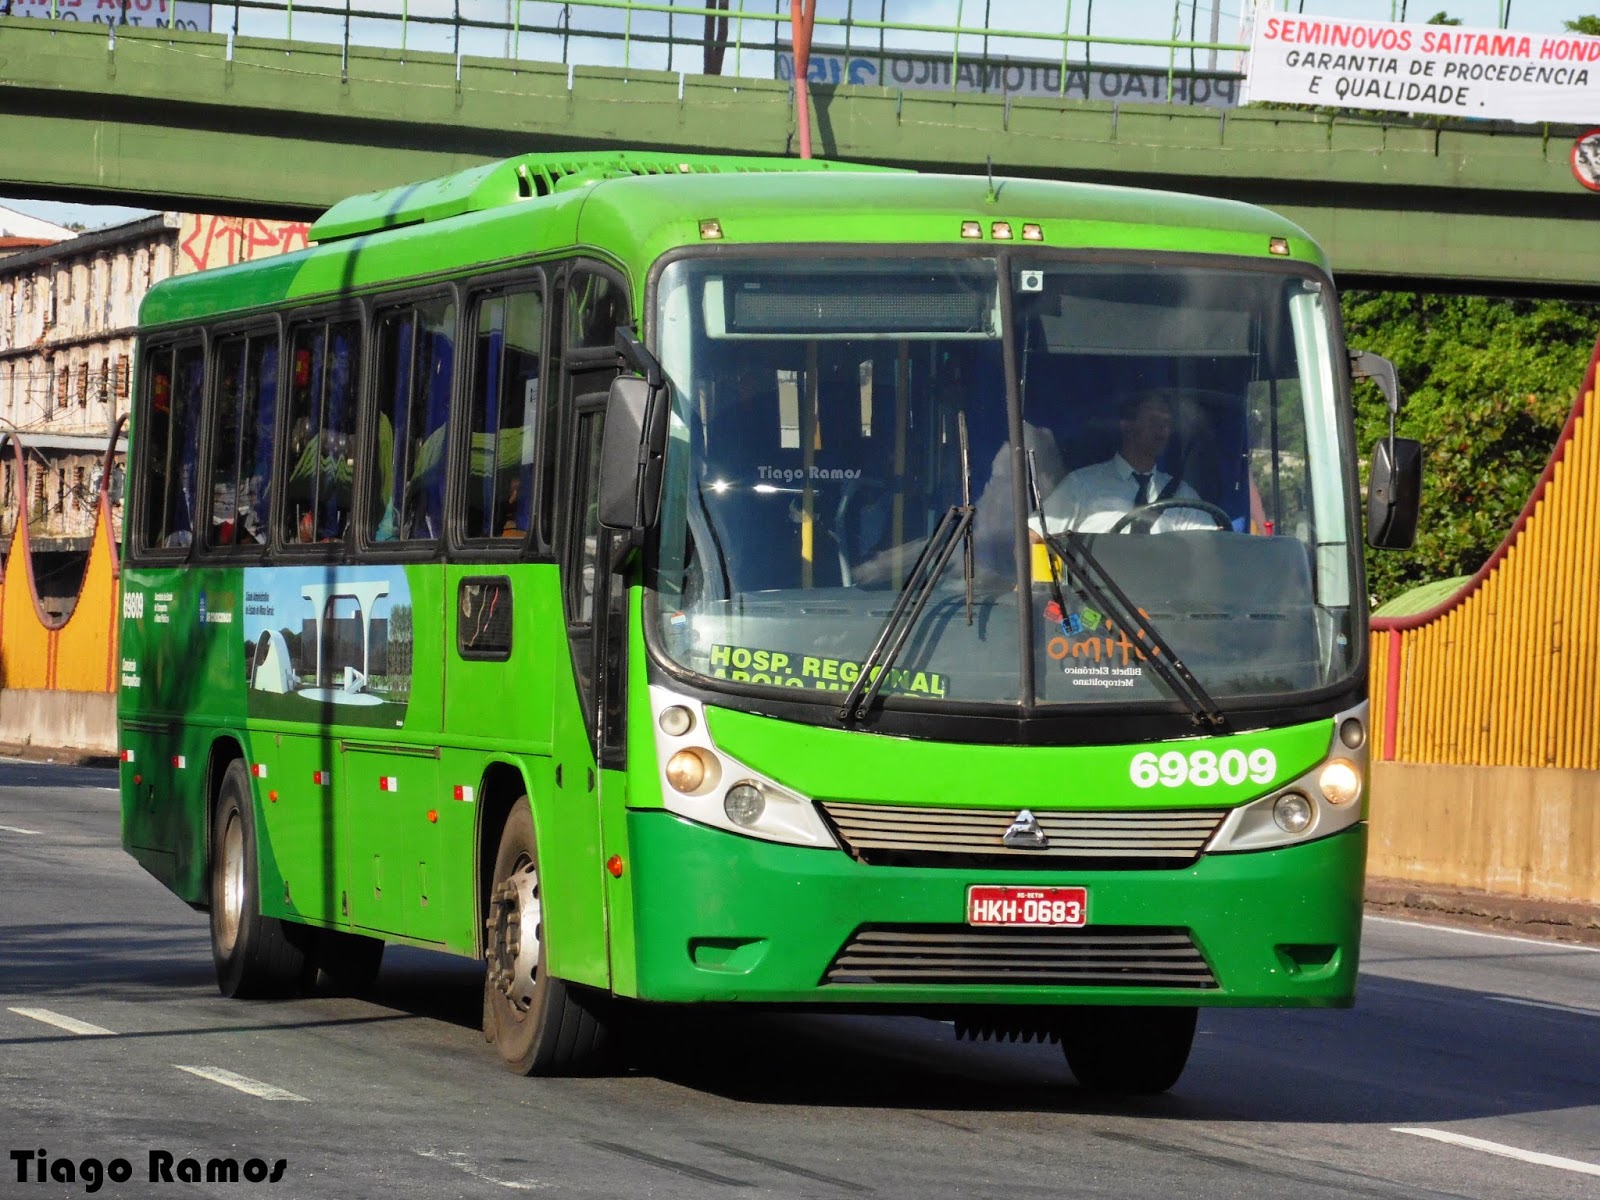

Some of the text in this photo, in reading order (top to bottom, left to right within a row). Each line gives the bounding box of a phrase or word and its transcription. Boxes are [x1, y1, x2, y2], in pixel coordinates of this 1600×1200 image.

[1264, 18, 1411, 51] SEMINOVOS
[1420, 31, 1531, 58] SAITAMA
[1286, 50, 1589, 86] GARANTIA DE PROCEDÊNCIA
[1308, 76, 1323, 94] E
[1335, 77, 1469, 107] QUALIDADE
[710, 645, 944, 695] HOSP. REGONAL
[1129, 748, 1277, 789] 69809
